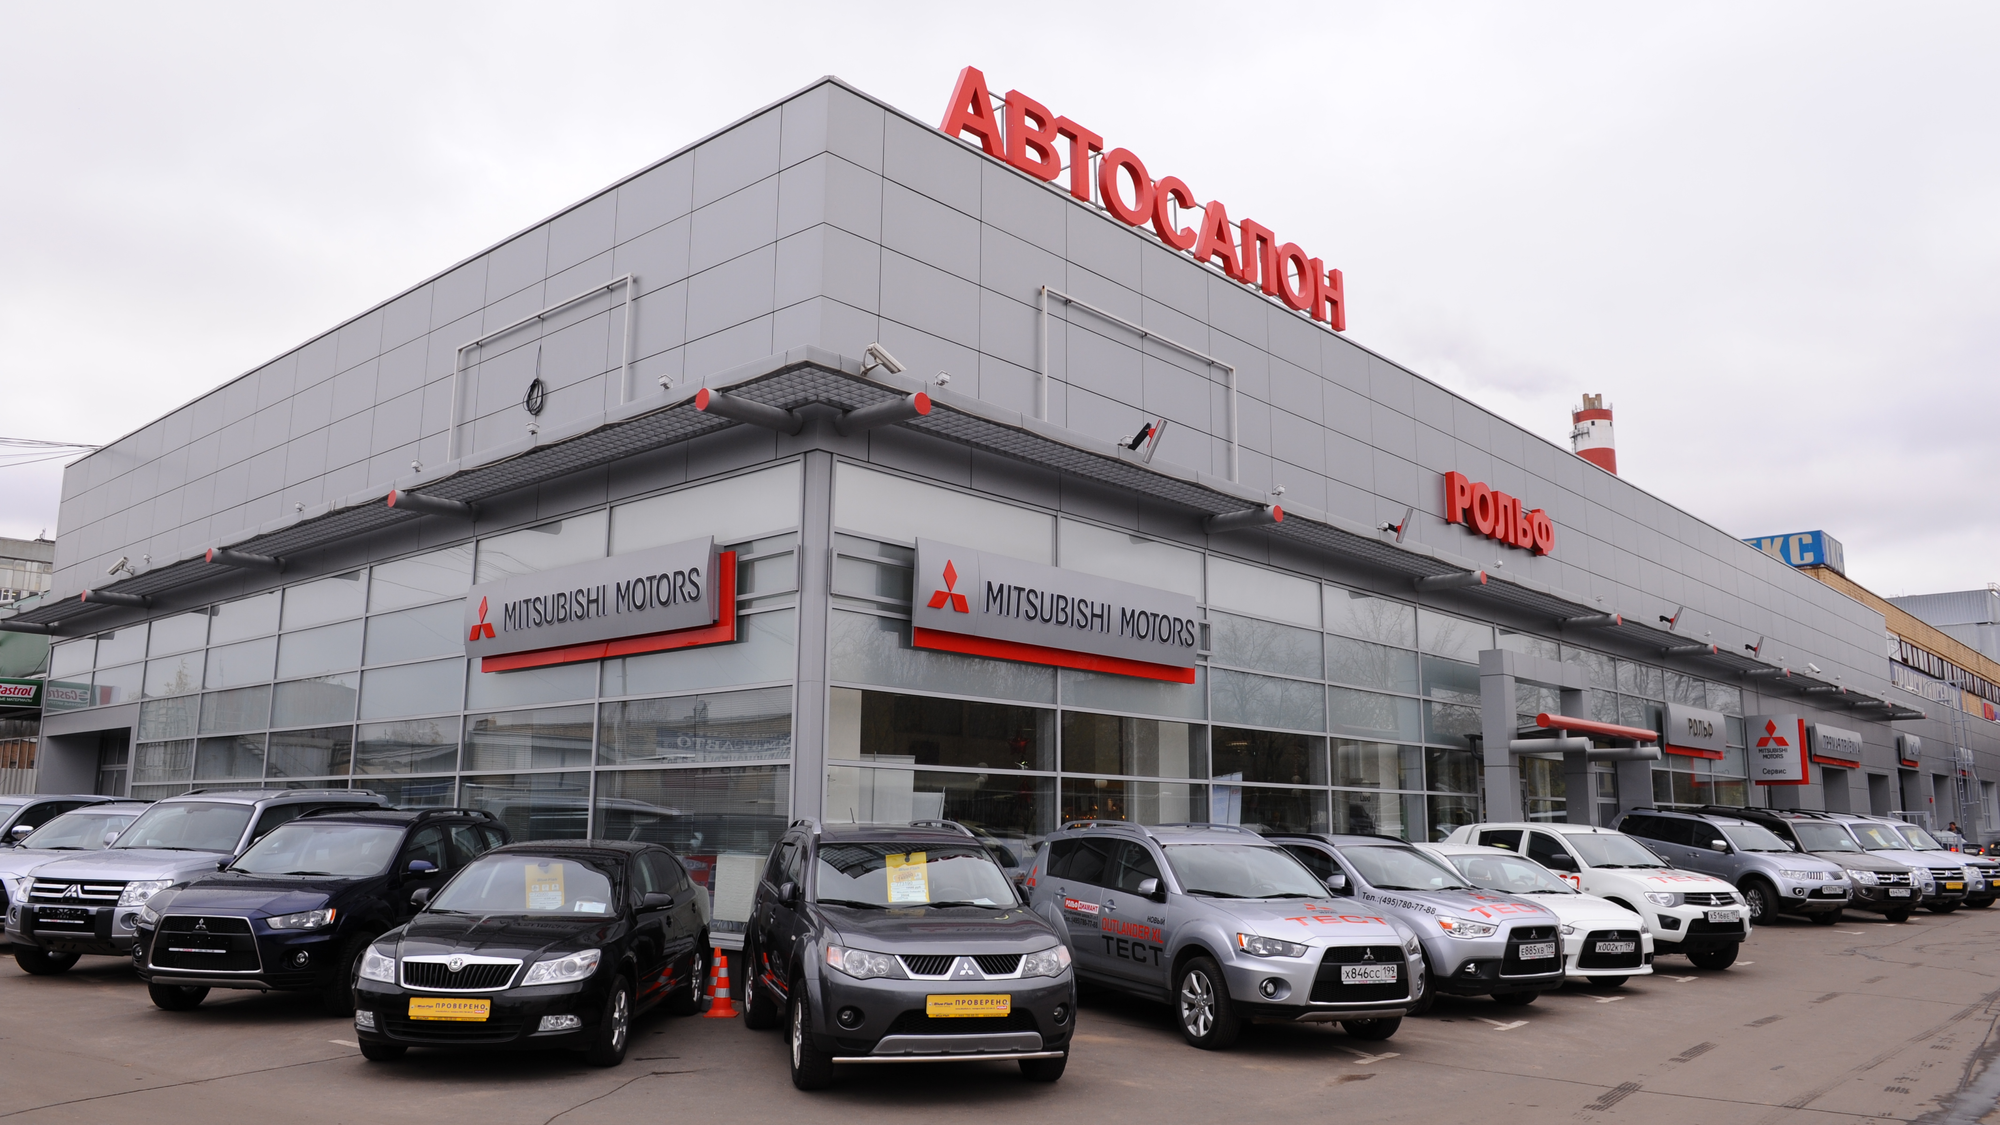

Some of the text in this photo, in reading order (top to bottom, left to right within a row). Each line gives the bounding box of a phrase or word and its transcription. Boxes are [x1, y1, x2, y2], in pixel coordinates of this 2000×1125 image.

[940, 65, 1346, 331] АВТОСАЛОН
[1445, 471, 1555, 556] РОЛЬФ
[1746, 533, 1814, 565] КС
[504, 567, 701, 632] MITSUBISHI MOTORS
[984, 580, 1196, 648] MITSUBISHI MOTORS
[1688, 717, 1714, 739] РОЛЬФ
[1762, 767, 1787, 775] Сервис
[1102, 917, 1164, 944] OUTLANDER XL
[1284, 915, 1387, 926] ТЕСТ
[1102, 934, 1163, 967] ТЕСТ
[435, 1002, 486, 1010] ПРОВЕРЕНО
